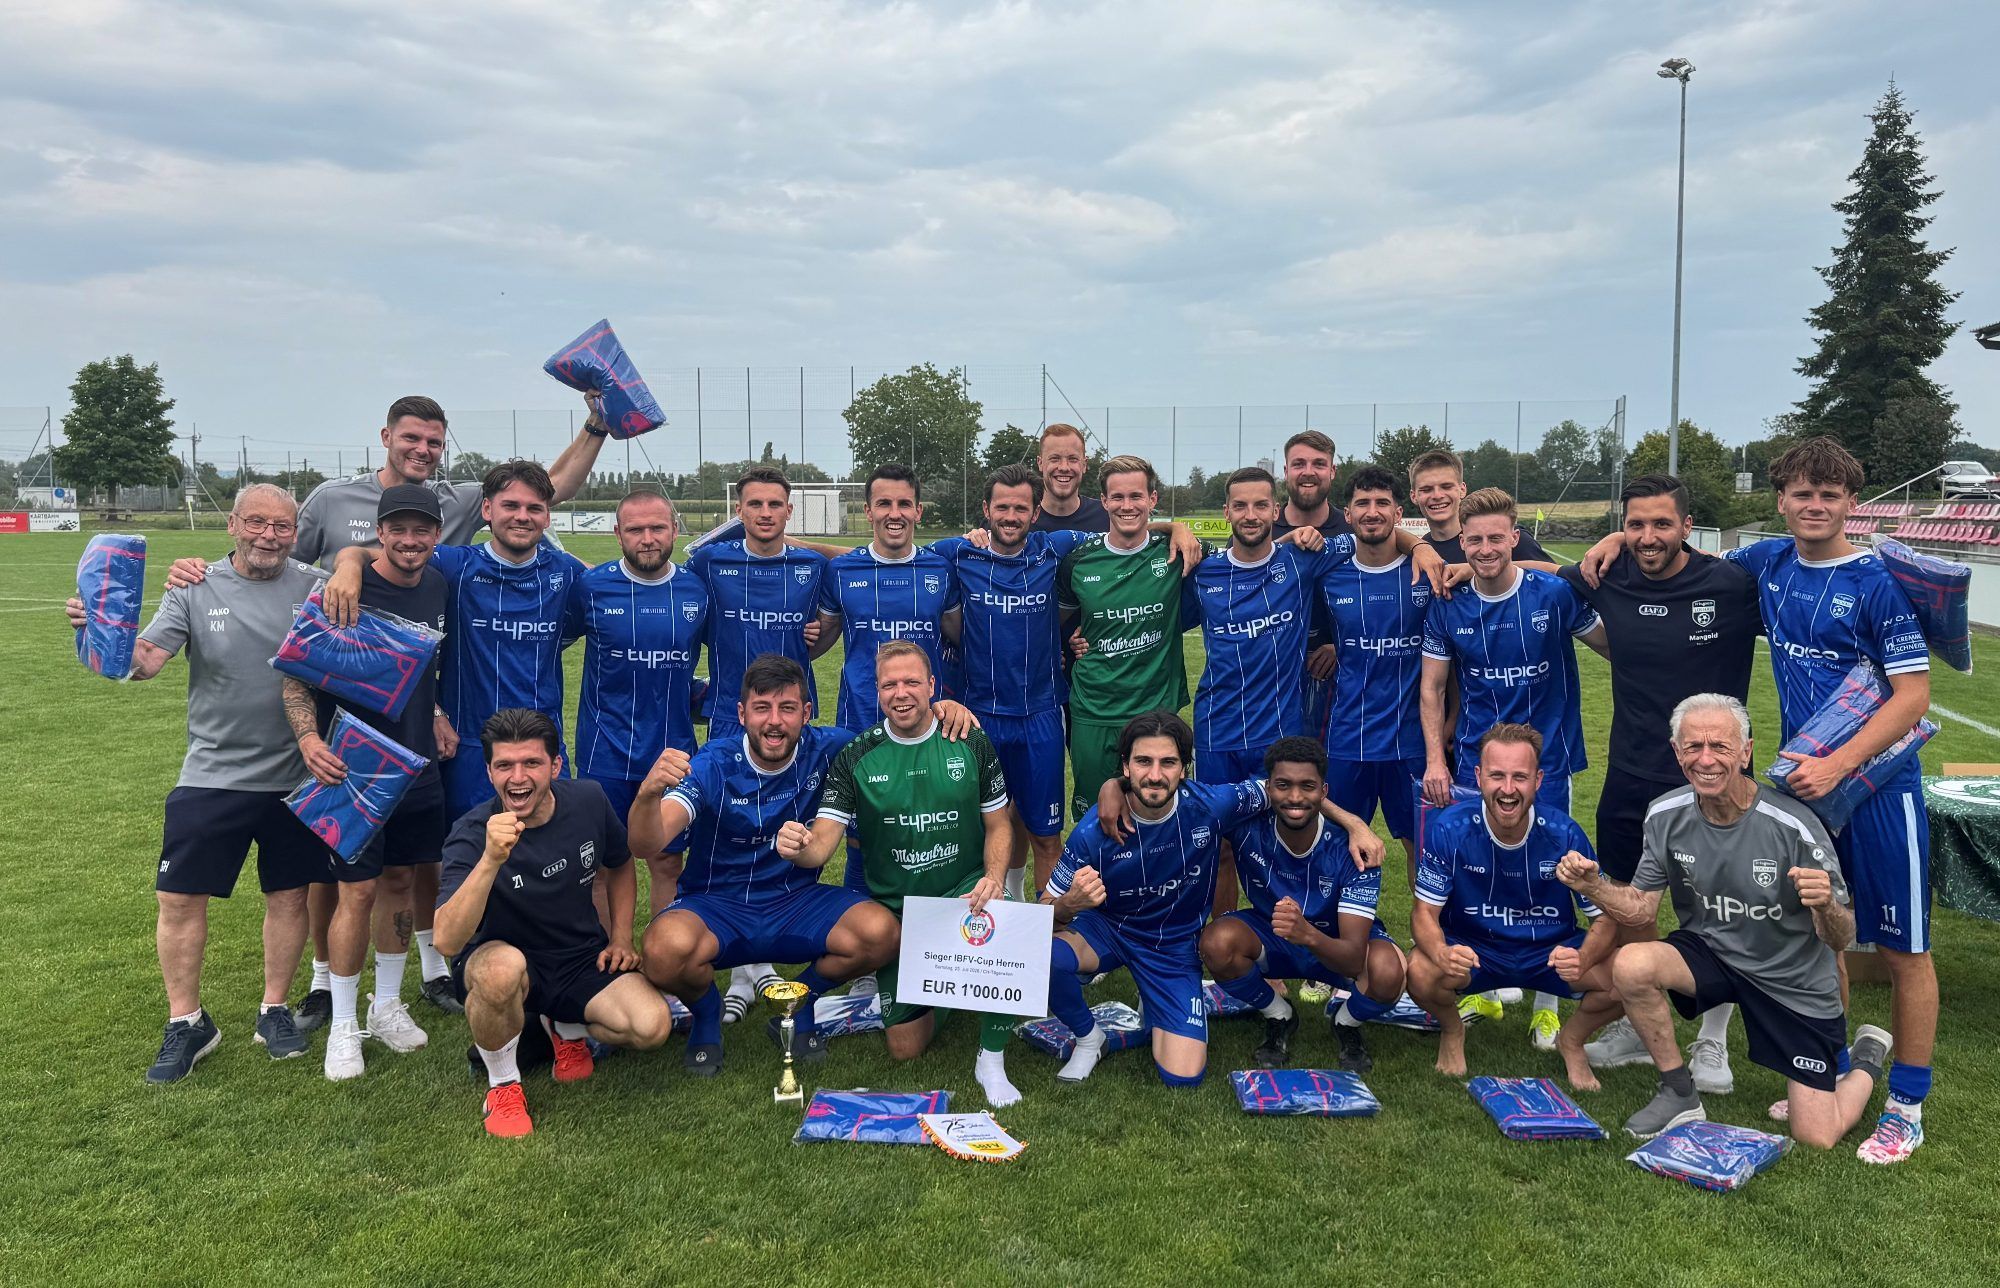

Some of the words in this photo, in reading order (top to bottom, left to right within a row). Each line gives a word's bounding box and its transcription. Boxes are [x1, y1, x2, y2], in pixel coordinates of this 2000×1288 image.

[348, 520, 371, 528] JAKO
[351, 530, 365, 541] KM
[472, 575, 493, 584] JAKO
[208, 608, 229, 616] JAKO
[984, 592, 1046, 614] typico
[740, 608, 803, 630] typico
[1107, 603, 1163, 623] typico
[1882, 614, 1917, 626] WOLF
[210, 620, 224, 631] KM
[492, 618, 557, 640] typico
[871, 619, 933, 639] typico
[1227, 611, 1293, 638] typico
[1098, 630, 1162, 652] Mohrenbräu
[1360, 636, 1422, 657] typico
[1689, 632, 1718, 642] Mangold
[628, 649, 689, 669] typico
[1484, 660, 1549, 687] typico
[868, 774, 888, 783] JAKO
[1050, 802, 1059, 816] 16
[899, 811, 958, 832] typico
[1112, 851, 1132, 861] JAKO
[1674, 852, 1695, 864] JAKO
[1463, 864, 1486, 874] JAKO
[1482, 903, 1559, 926] typico
[1702, 895, 1783, 922] ypico
[1882, 904, 1896, 924] 11
[1880, 924, 1902, 935] JAKO
[924, 952, 952, 962] Sieger
[954, 954, 994, 967] IBFV-Cup
[996, 958, 1025, 969] Herren
[923, 979, 956, 995] EUR
[962, 983, 1022, 1002] 1'000.00
[1191, 997, 1202, 1016] 10
[1186, 1016, 1203, 1027] JAKO
